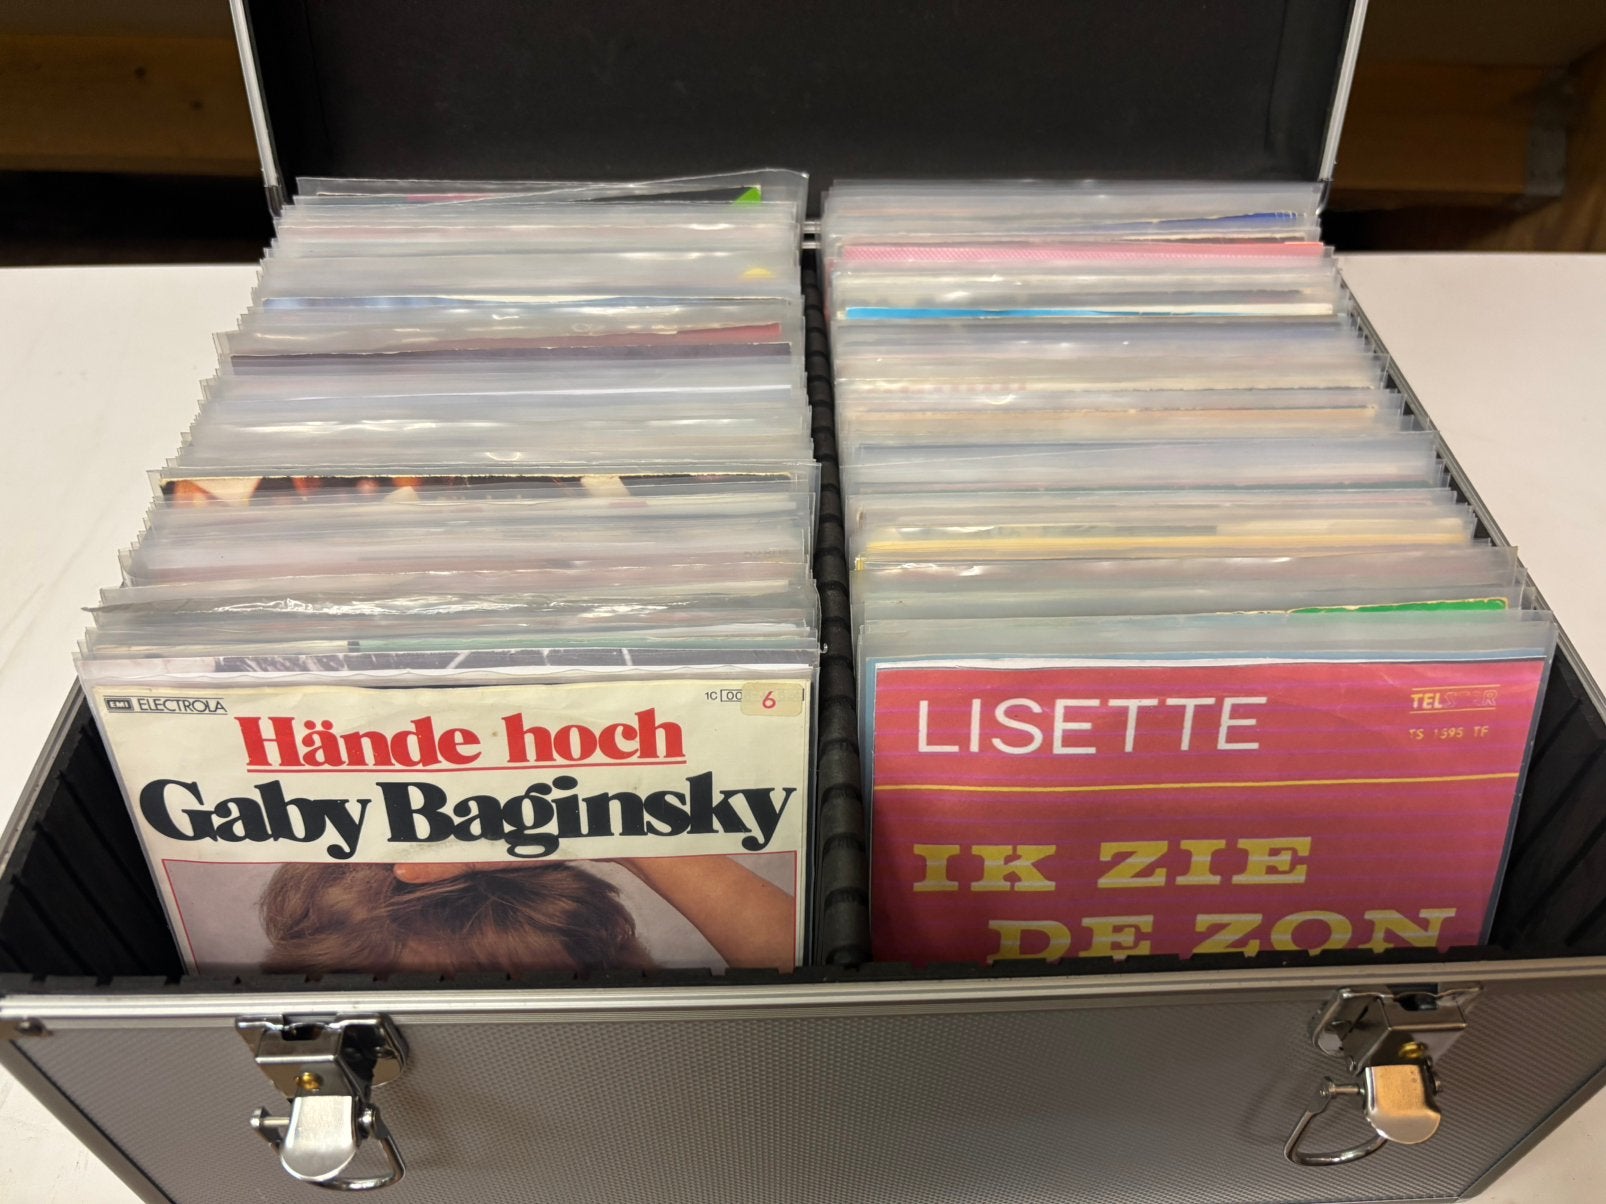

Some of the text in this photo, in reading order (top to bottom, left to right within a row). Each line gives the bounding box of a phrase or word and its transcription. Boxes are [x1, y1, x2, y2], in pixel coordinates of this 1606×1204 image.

[138, 698, 228, 713] ELECTROLA
[762, 690, 776, 709] 6
[918, 696, 1268, 755] LISETTE
[234, 707, 686, 768] Hände hoch
[1409, 728, 1424, 740] TS
[1473, 725, 1489, 738] TF
[138, 771, 798, 860] Gaby Baginsky
[912, 837, 1313, 892] IK ZIE
[986, 907, 1457, 962] DE ZON
